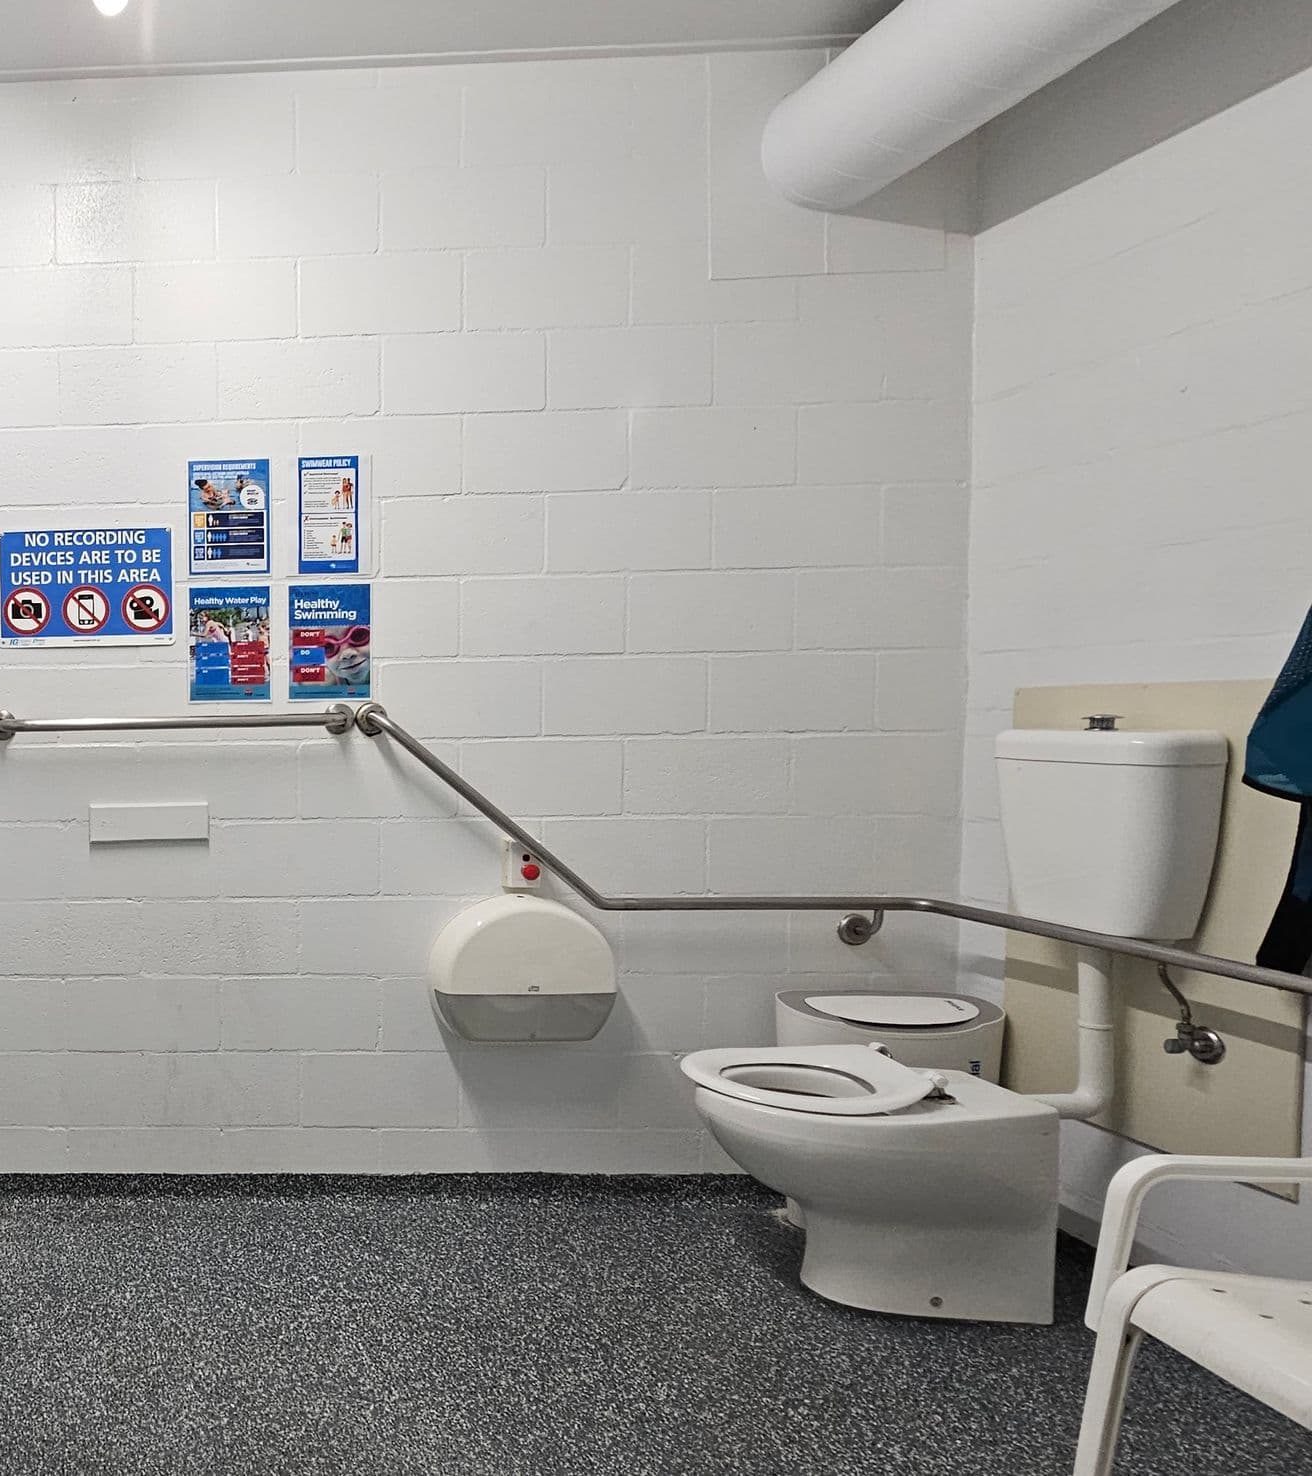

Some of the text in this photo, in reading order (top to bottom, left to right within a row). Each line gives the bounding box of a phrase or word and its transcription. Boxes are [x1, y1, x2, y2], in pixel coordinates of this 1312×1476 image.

[24, 530, 145, 547] NO RECORDING
[10, 549, 161, 566] DEVICES ARE TO BE
[11, 568, 161, 585] USED IN THIS AREA
[194, 597, 224, 606] Healthy
[250, 596, 267, 605] Play
[294, 598, 340, 610] Healthy
[294, 609, 357, 620] Swimming
